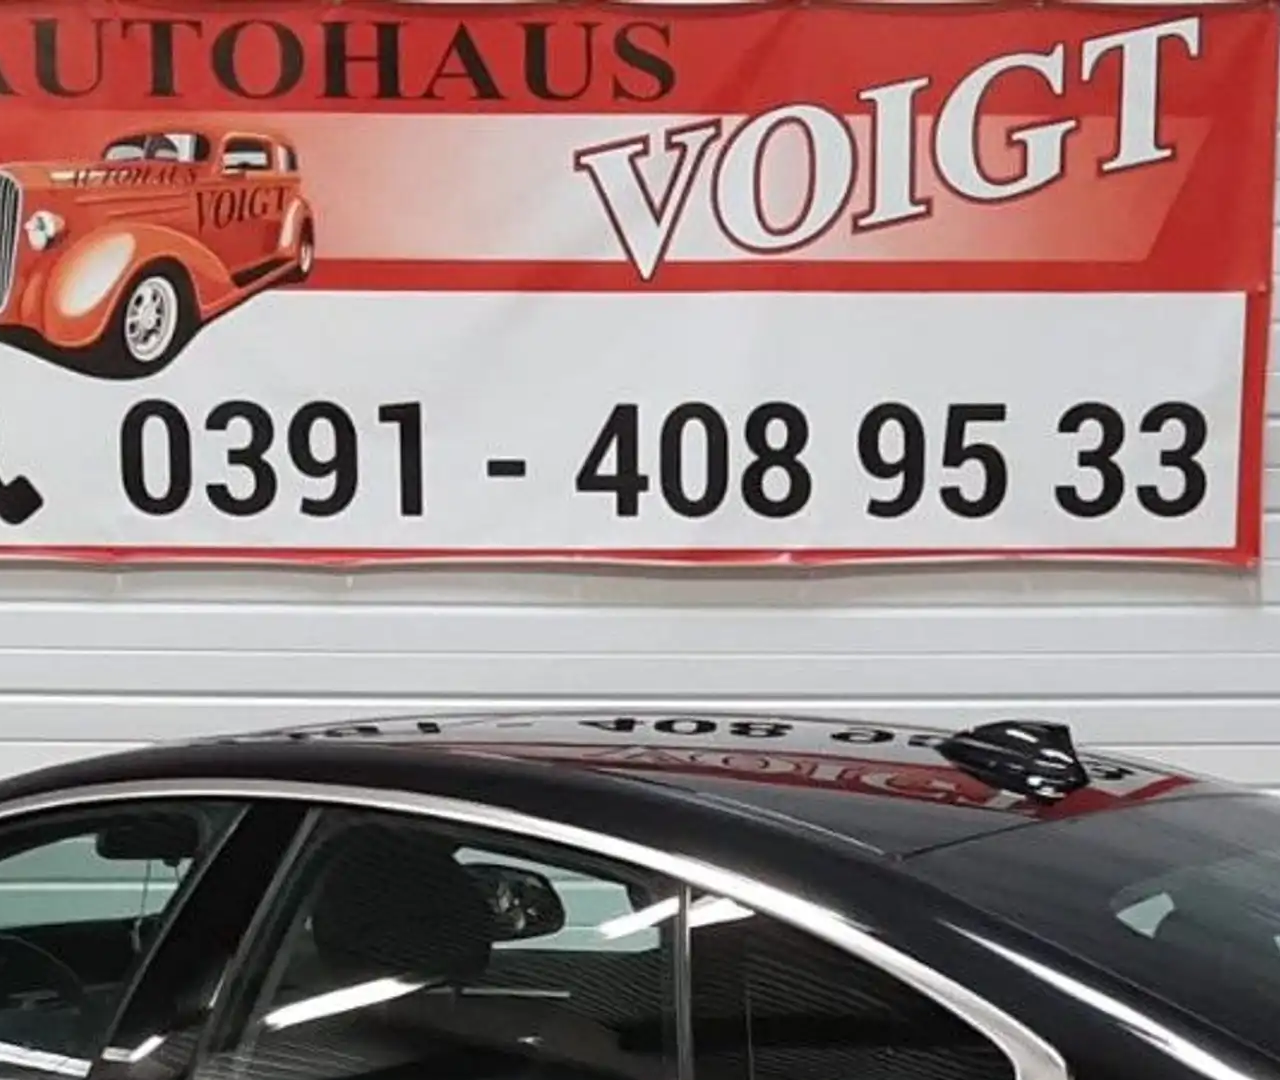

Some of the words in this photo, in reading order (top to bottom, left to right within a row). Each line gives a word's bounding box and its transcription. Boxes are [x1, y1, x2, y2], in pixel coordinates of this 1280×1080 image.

[574, 15, 1203, 282] VOIGT
[195, 186, 293, 236] VOIGT
[120, 398, 424, 517] 0391
[575, 400, 813, 519] 408
[856, 401, 1008, 518] 95
[1053, 400, 1209, 518] 33
